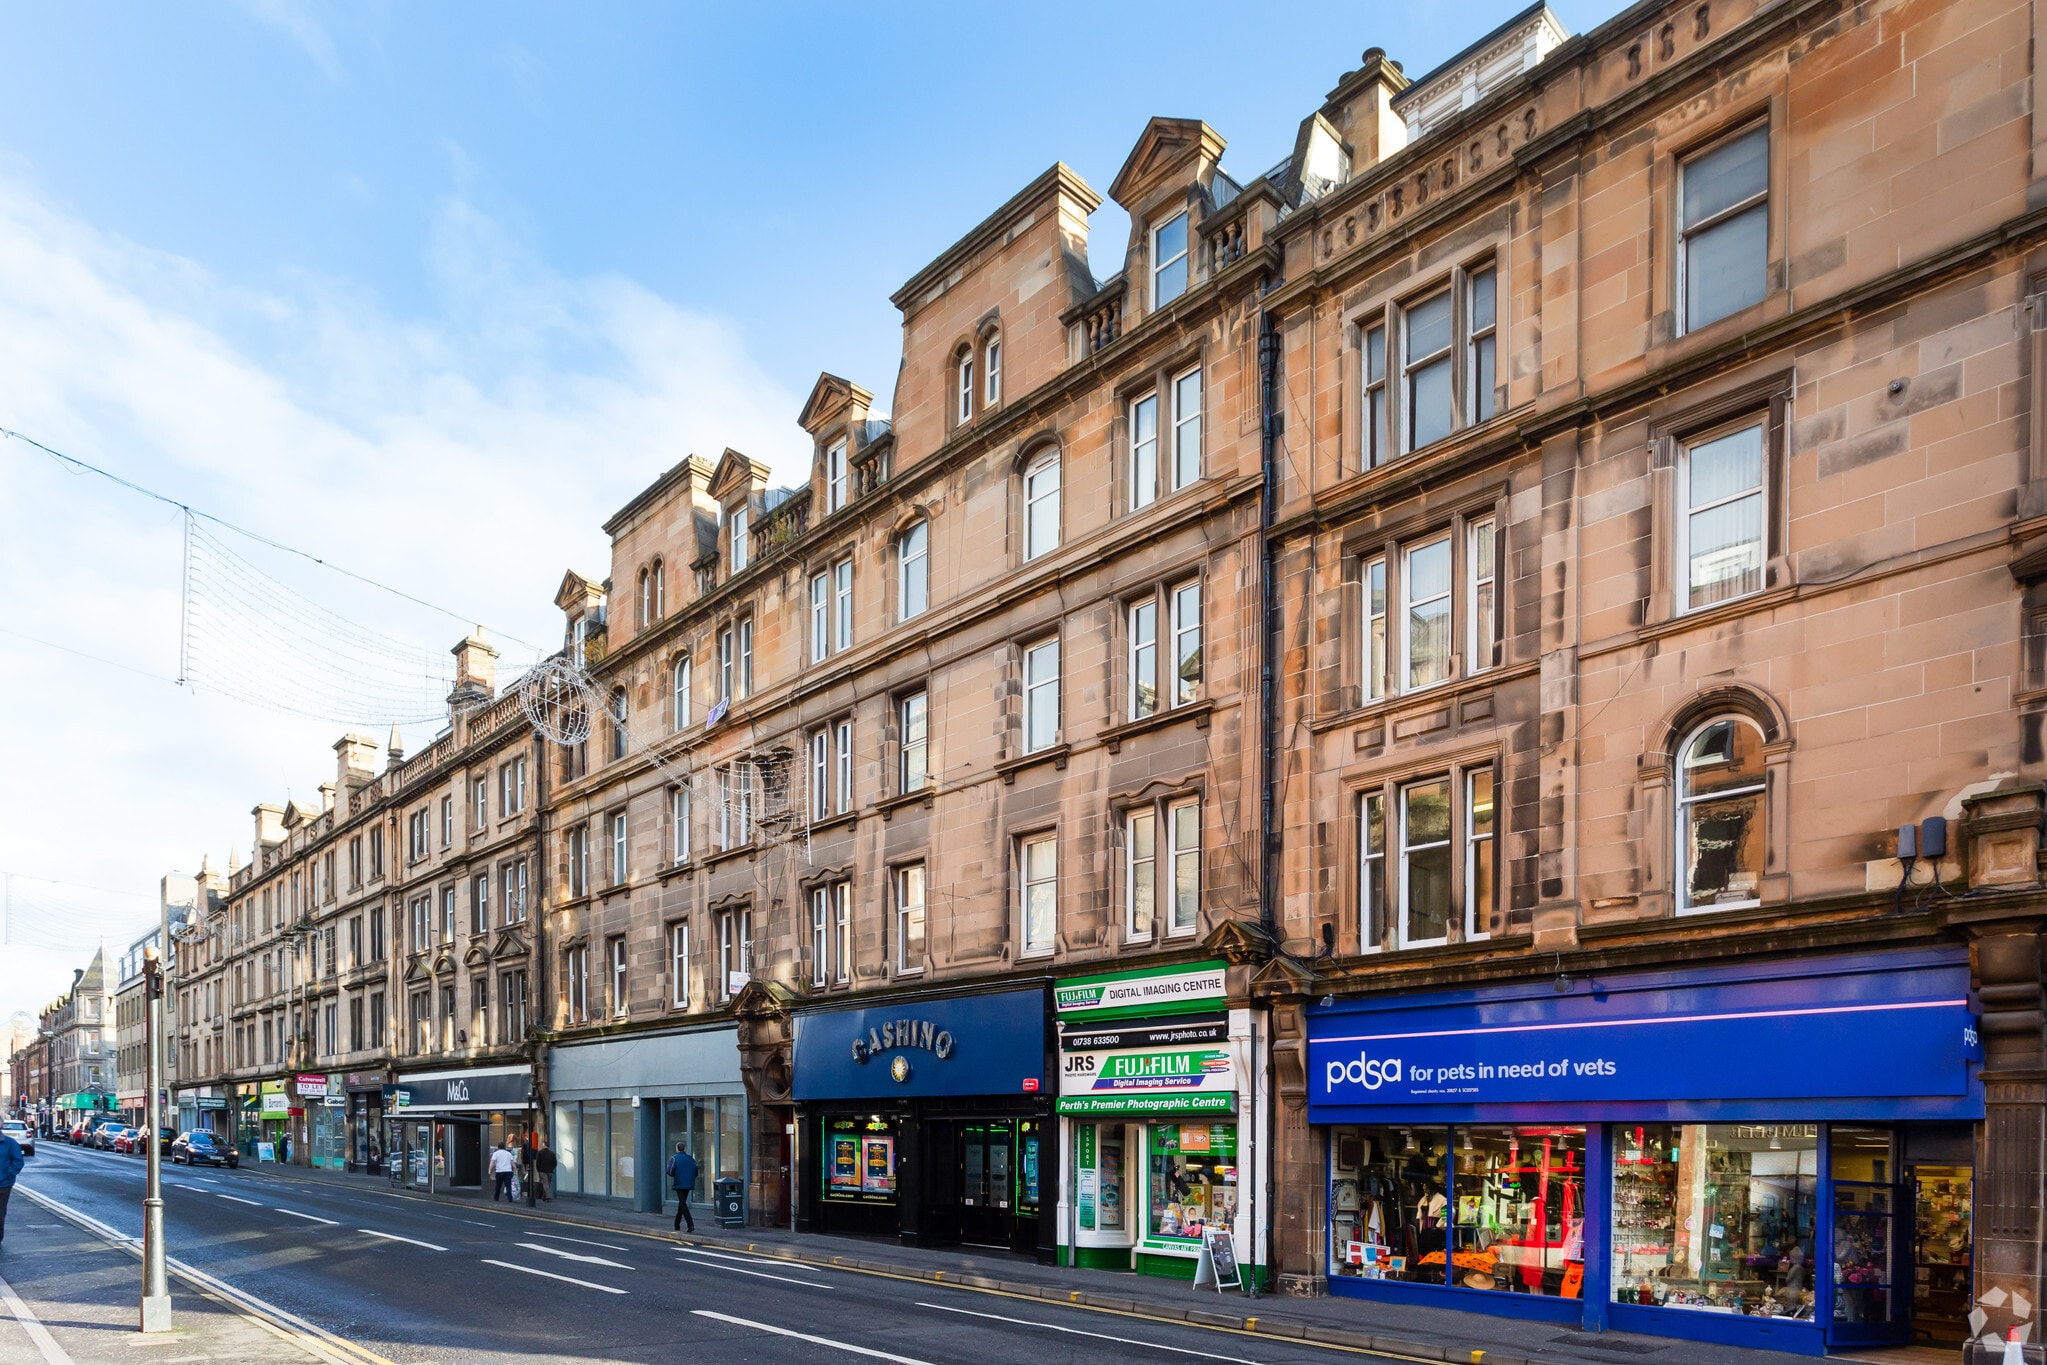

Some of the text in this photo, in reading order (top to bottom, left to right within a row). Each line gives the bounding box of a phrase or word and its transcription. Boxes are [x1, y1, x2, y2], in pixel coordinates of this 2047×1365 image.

[1109, 978, 1222, 1000] DIGITAL IMAGING CENTRE
[851, 1018, 954, 1064] CASHINO
[1072, 1035, 1120, 1046] 01738 633500
[1064, 1055, 1095, 1072] JRS
[1327, 1050, 1402, 1093] pdsa
[1409, 1058, 1617, 1084] for pets in need of vets
[1113, 1077, 1192, 1088] Digital Imaging Service
[1059, 1097, 1227, 1110] Perth's Premier Photographic Centre
